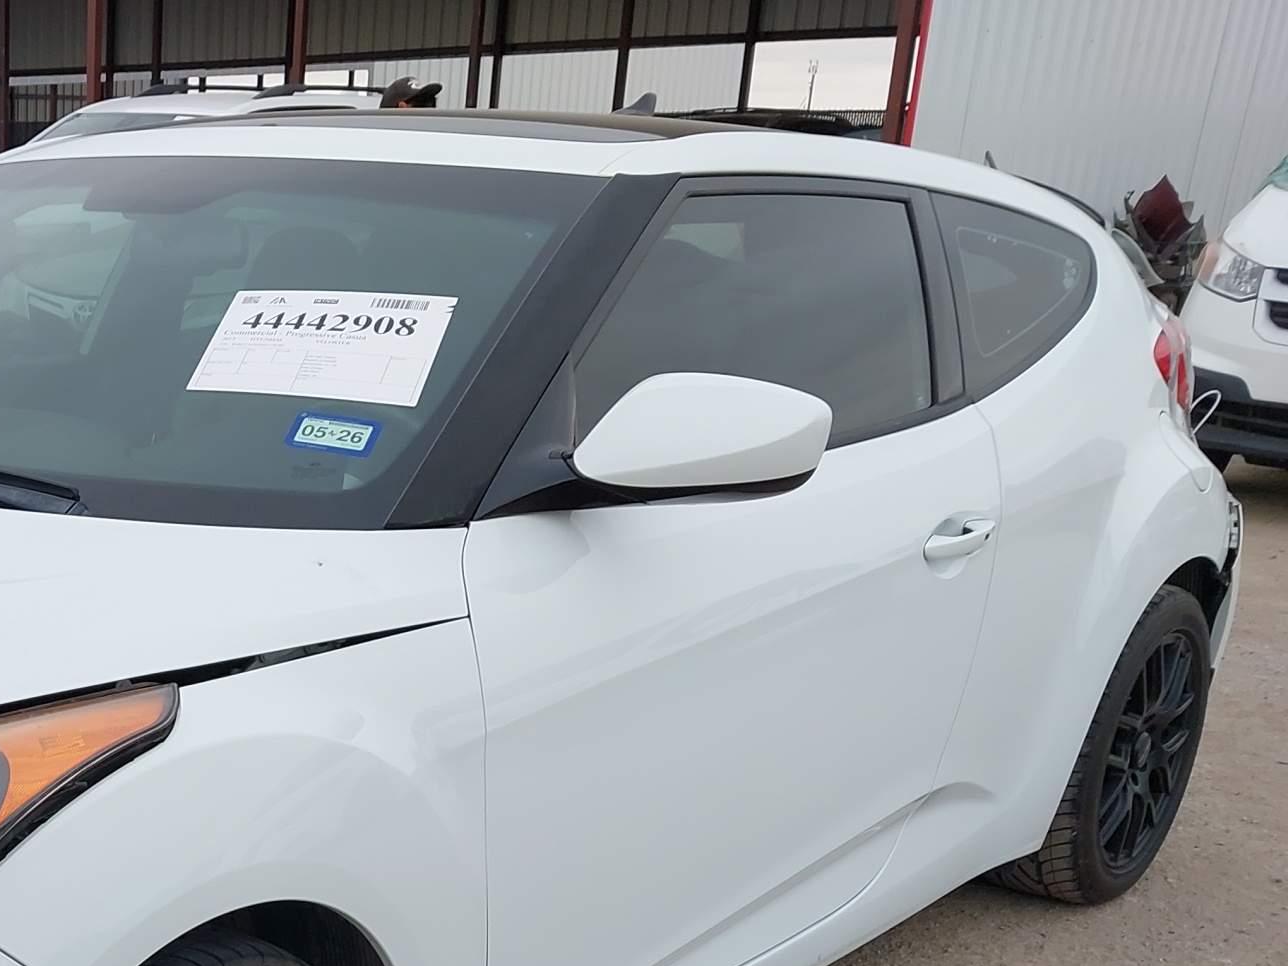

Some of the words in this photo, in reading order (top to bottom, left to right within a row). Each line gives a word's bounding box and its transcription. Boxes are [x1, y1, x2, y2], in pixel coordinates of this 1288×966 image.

[242, 311, 418, 337] 44442908
[223, 329, 278, 337] Commercial
[285, 330, 337, 340] Progressive
[301, 424, 329, 438] 05
[335, 429, 364, 444] 26
